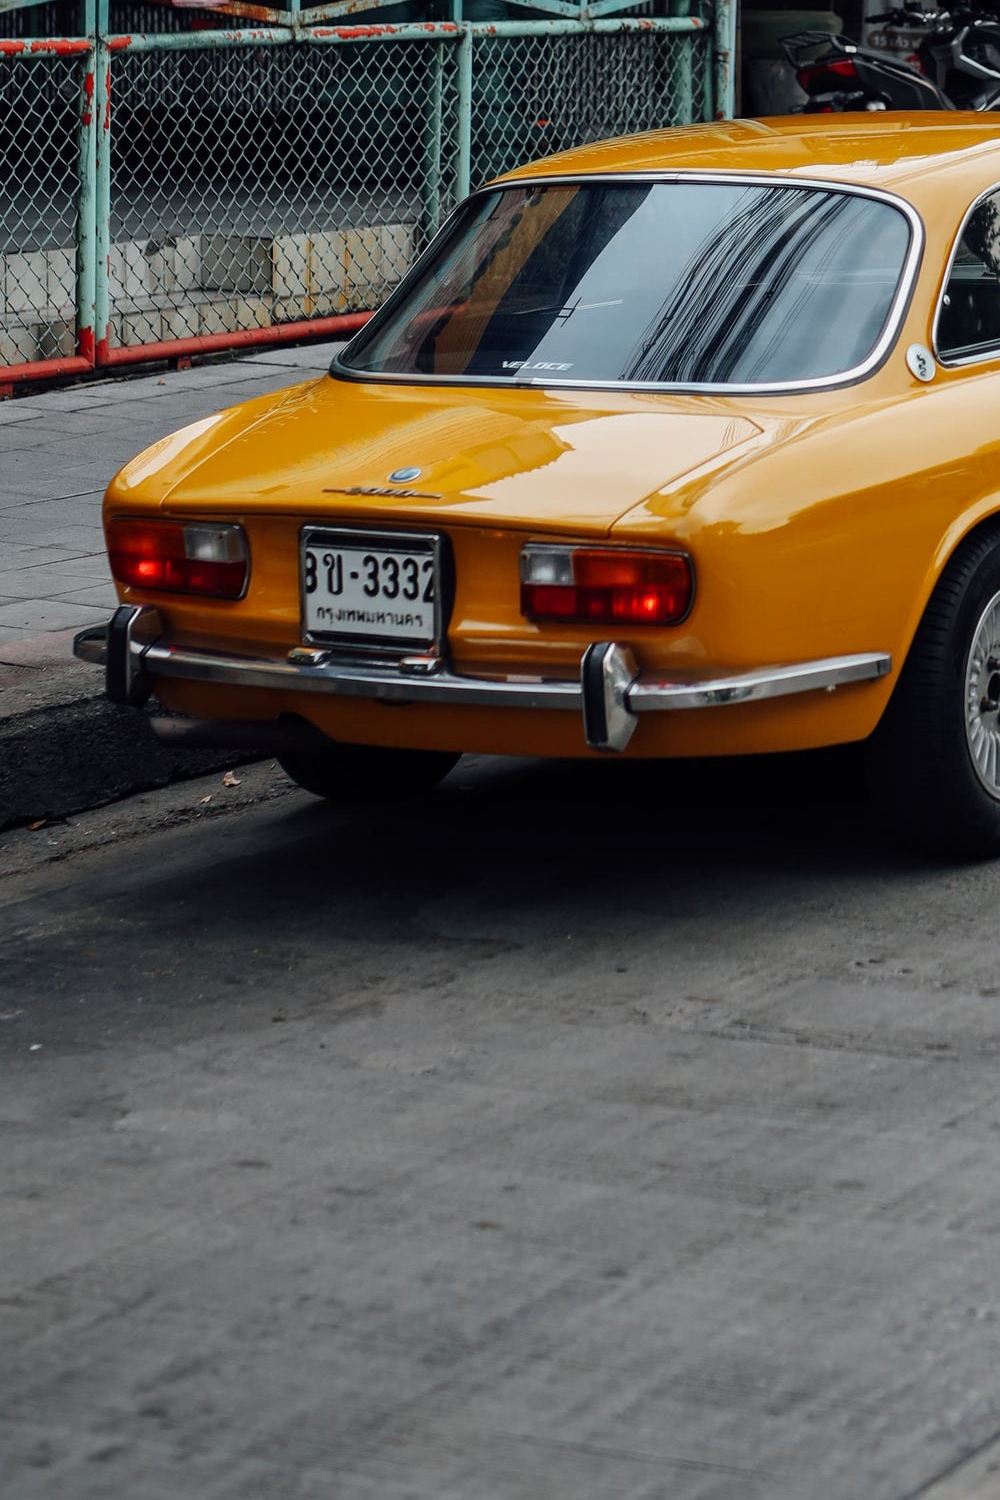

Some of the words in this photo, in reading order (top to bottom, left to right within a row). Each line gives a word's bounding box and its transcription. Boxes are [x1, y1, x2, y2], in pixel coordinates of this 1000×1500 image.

[502, 360, 575, 371] VELOCE
[316, 606, 424, 628] กรุงเทพมหานคร
